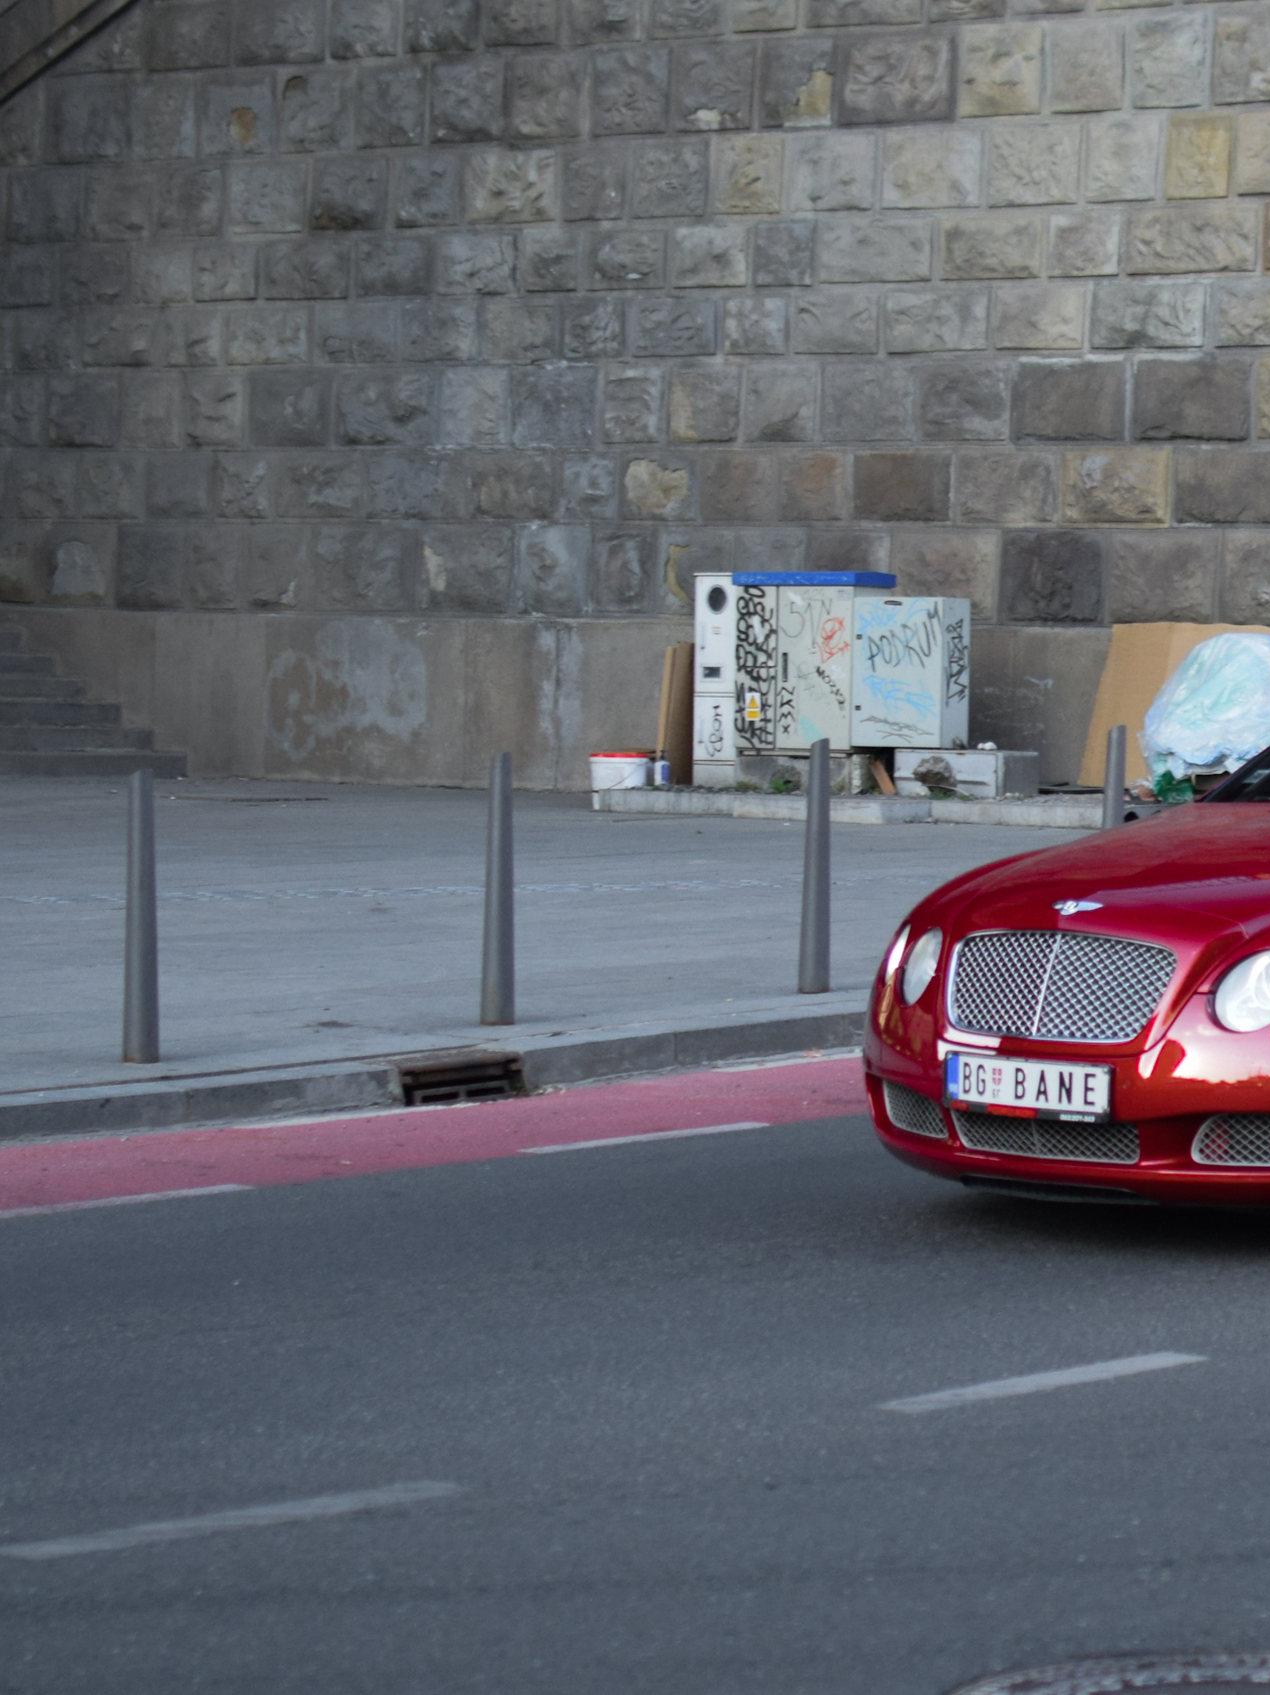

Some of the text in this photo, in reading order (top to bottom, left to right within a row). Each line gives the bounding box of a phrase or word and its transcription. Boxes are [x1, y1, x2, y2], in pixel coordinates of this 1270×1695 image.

[867, 601, 942, 673] PODRUM
[962, 1062, 1097, 1106] BG BANE
